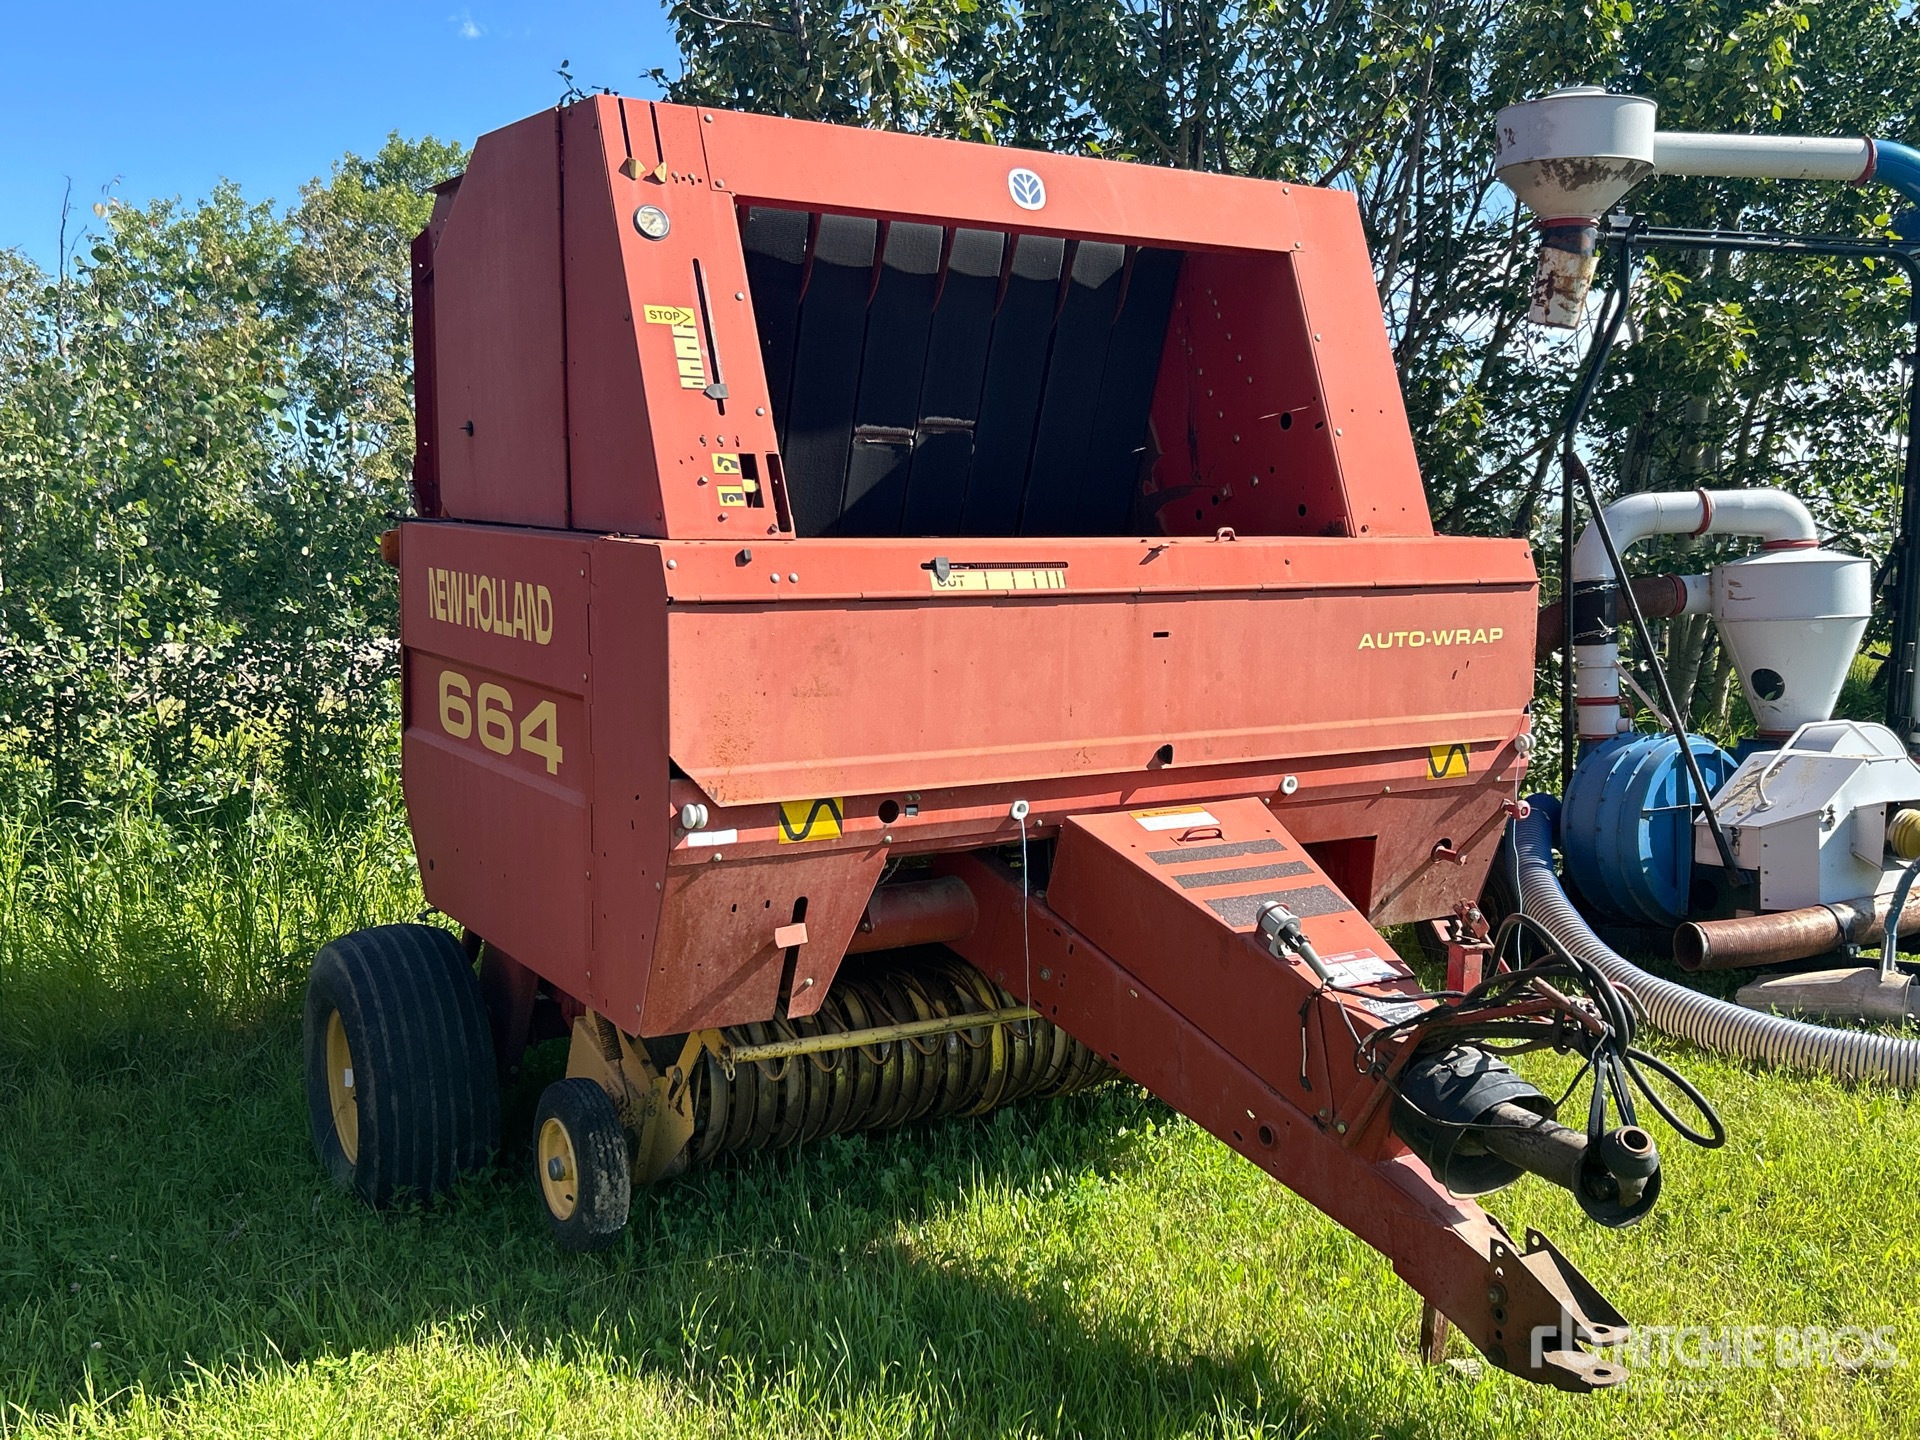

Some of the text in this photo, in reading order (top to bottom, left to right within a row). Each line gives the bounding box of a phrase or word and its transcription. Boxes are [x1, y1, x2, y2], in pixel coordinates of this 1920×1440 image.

[649, 310, 680, 321] STOP
[428, 567, 554, 646] NEW HOLLAND
[1358, 627, 1504, 650] AUTO-WRAP
[438, 670, 564, 776] 664
